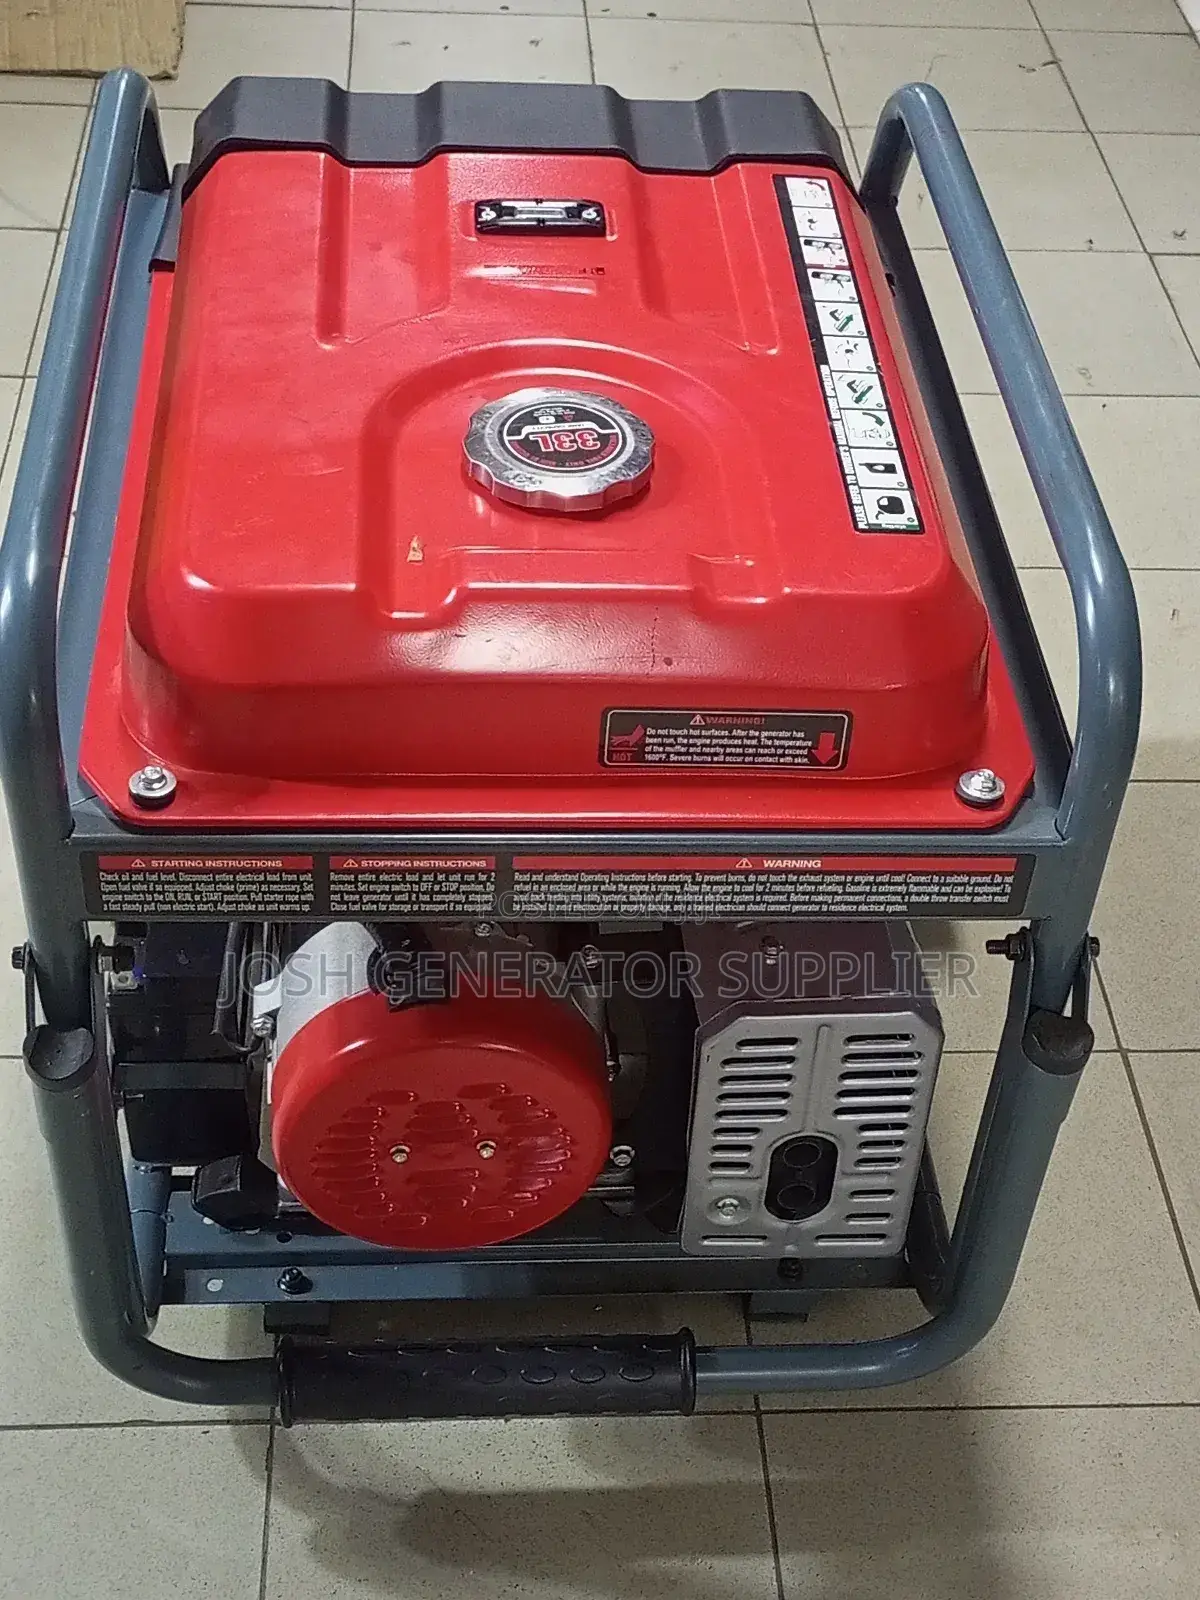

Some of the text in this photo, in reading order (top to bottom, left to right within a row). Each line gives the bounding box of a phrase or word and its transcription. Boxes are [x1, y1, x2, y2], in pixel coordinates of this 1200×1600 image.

[528, 430, 601, 452] 33L
[705, 716, 765, 725] WARNING!
[760, 730, 791, 738] generator
[793, 730, 805, 738] has
[689, 738, 711, 746] engine
[712, 738, 741, 746] produces
[773, 739, 812, 747] temperature
[702, 746, 724, 754] nearby
[612, 753, 633, 761] HOT
[693, 754, 711, 762] burns
[713, 754, 724, 762] will
[794, 756, 810, 764] skin.
[150, 860, 283, 868] STARTING INSTRUCTIONS
[413, 860, 487, 868] INSTRUCTIONS
[763, 859, 822, 868] WARNING
[132, 872, 144, 881] and
[146, 872, 158, 881] fuel
[282, 872, 297, 881] from
[330, 872, 355, 881] Remove
[379, 872, 402, 881] electric
[422, 872, 434, 881] and
[478, 872, 488, 881] for
[491, 872, 495, 881] 2
[514, 872, 530, 881] Read
[544, 872, 579, 881] understand
[580, 872, 610, 883] Operating
[611, 873, 646, 882] Instructions
[647, 873, 667, 882] before
[704, 873, 727, 884] prevent
[788, 873, 797, 882] the
[824, 873, 845, 884] system
[854, 873, 874, 884] engine
[906, 874, 931, 882] Connect
[303, 882, 314, 891] Set
[358, 882, 368, 891] Set
[420, 882, 433, 891] OFF
[441, 882, 458, 891] STOP
[486, 882, 495, 891] Do
[549, 883, 576, 891] enclosed
[618, 883, 628, 892] the
[629, 883, 650, 893] engine
[684, 884, 700, 892] Allow
[712, 884, 733, 894] engine
[765, 884, 770, 892] 2
[796, 884, 815, 892] before
[845, 884, 870, 892] Gasoline
[879, 884, 907, 894] extremely
[941, 884, 952, 893] and
[965, 884, 973, 893] be
[202, 893, 222, 901] START
[362, 892, 392, 902] generator
[433, 892, 466, 902] completely
[789, 894, 809, 902] Before
[811, 894, 833, 904] making
[834, 894, 865, 904] permanent
[949, 894, 972, 902] transfer
[767, 904, 791, 912] connect
[792, 904, 821, 913] generator
[829, 904, 857, 912] residence
[858, 904, 885, 912] electrical
